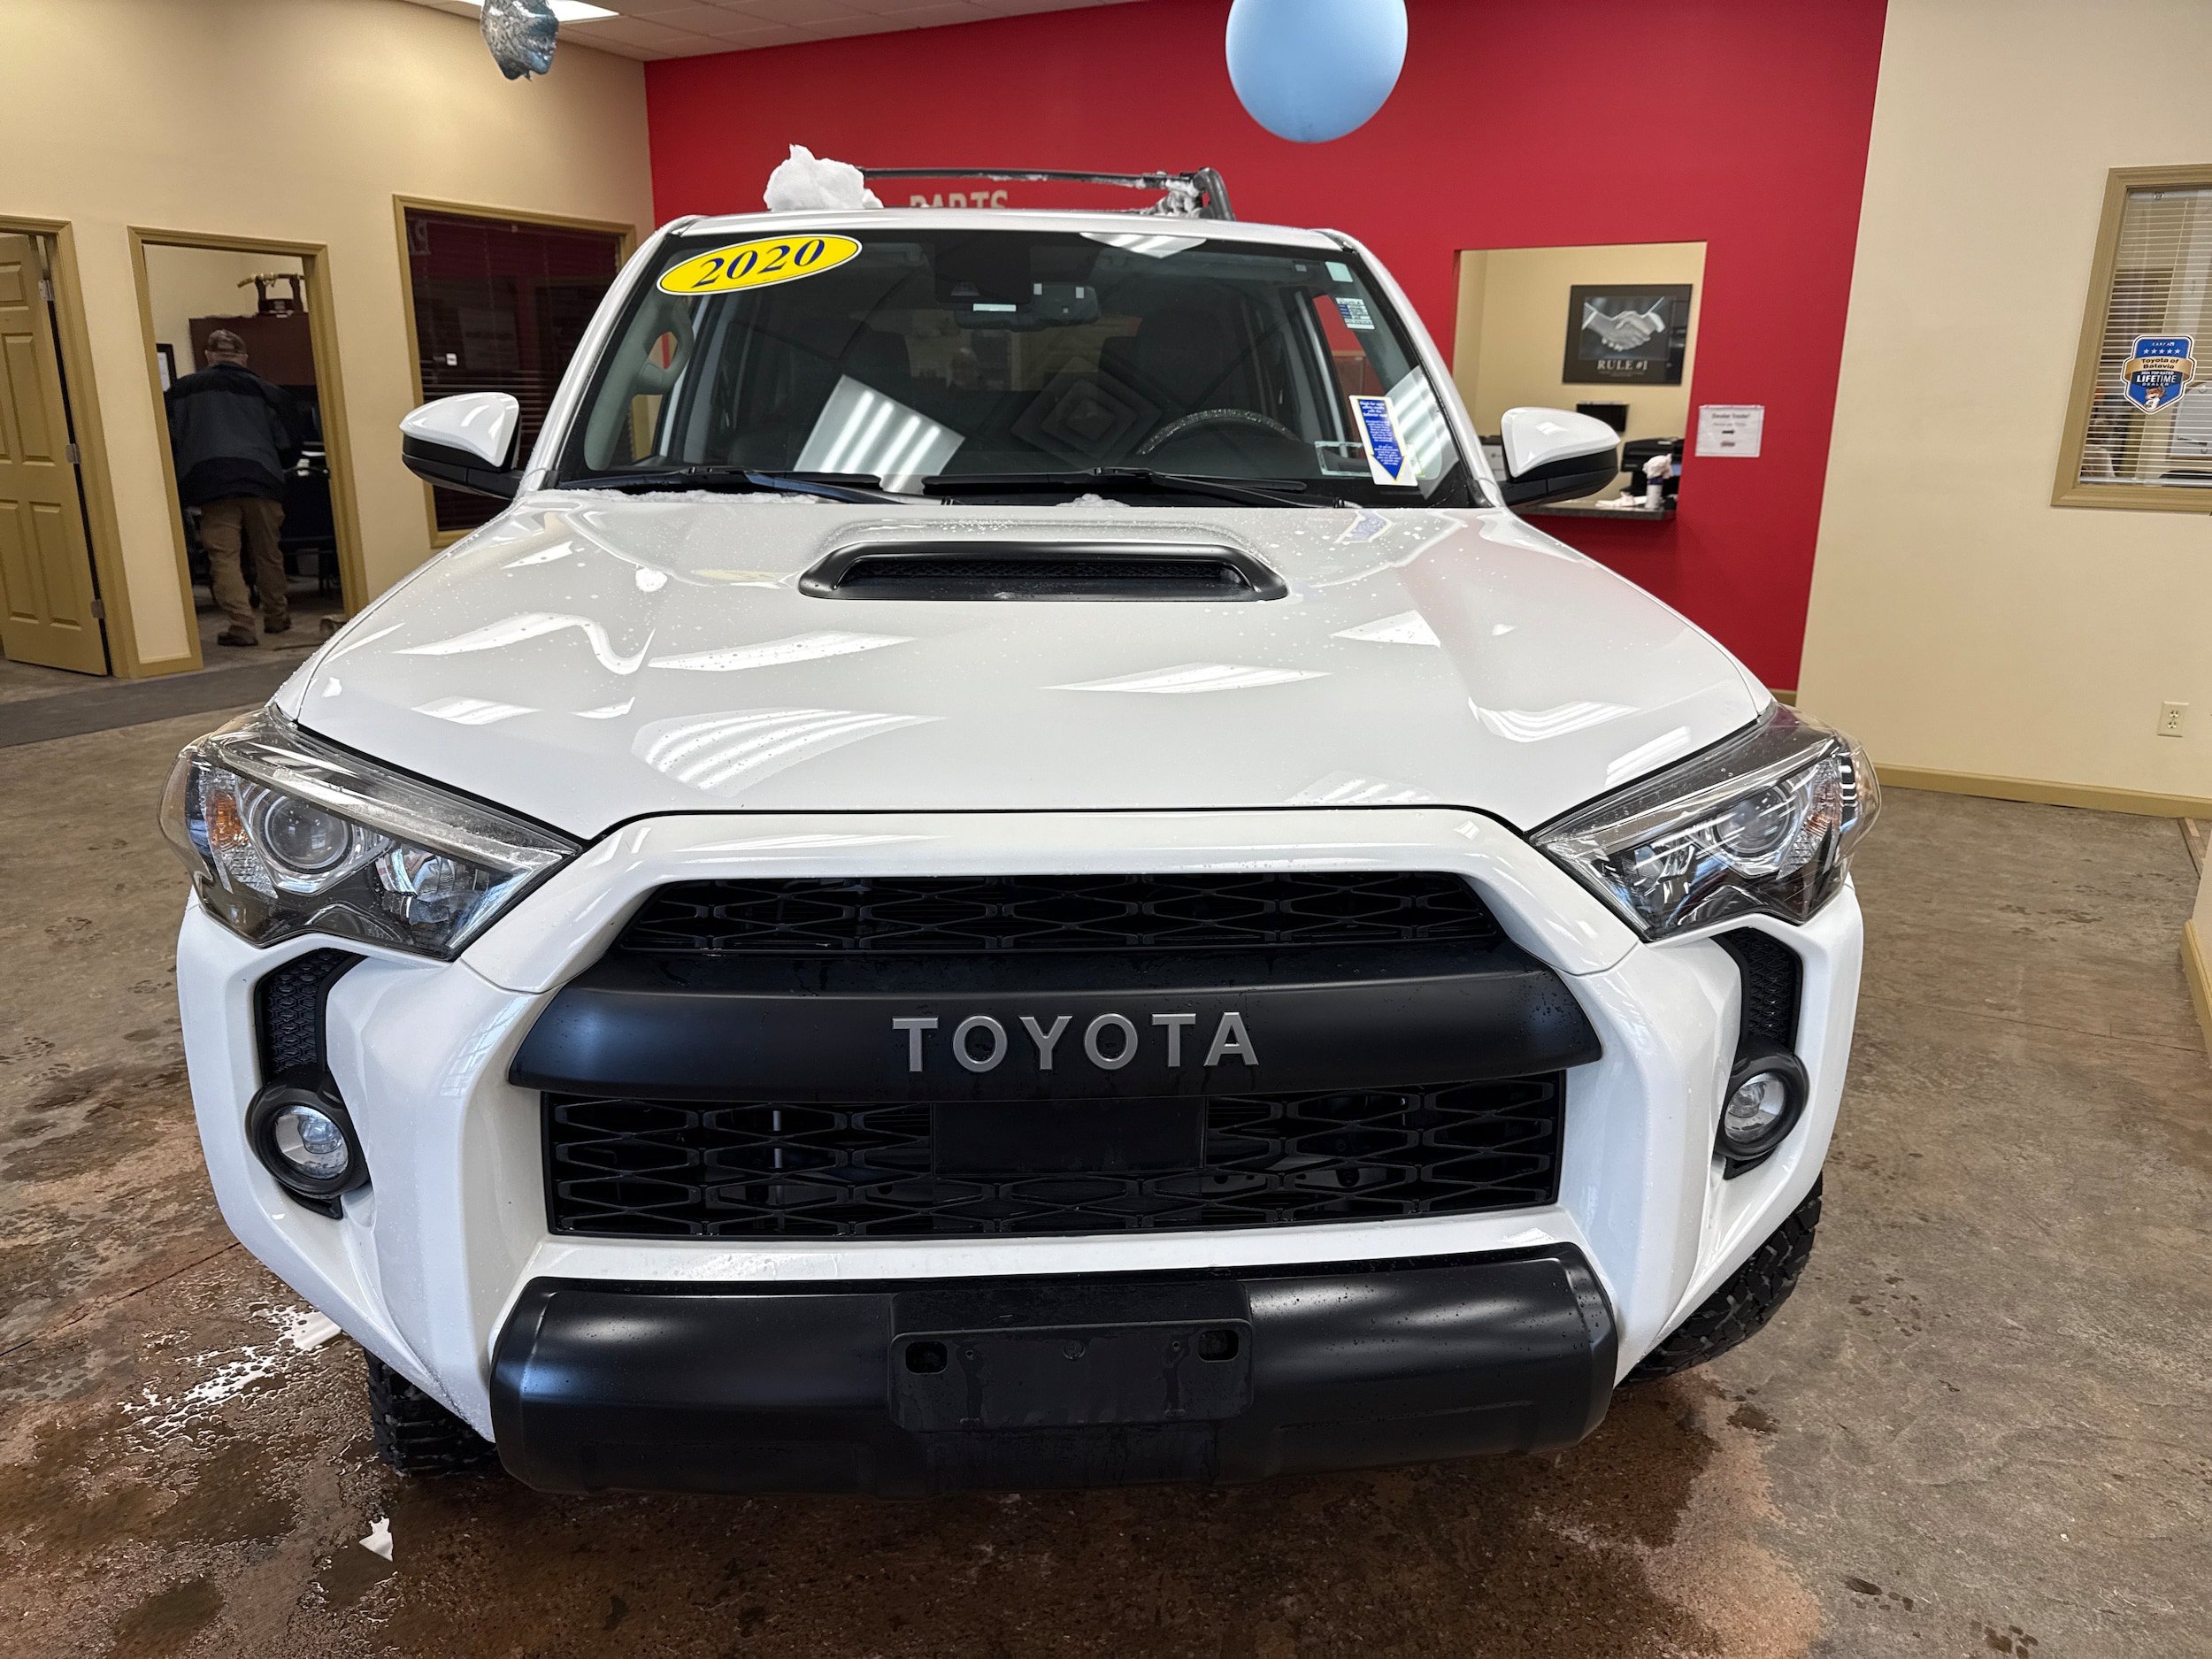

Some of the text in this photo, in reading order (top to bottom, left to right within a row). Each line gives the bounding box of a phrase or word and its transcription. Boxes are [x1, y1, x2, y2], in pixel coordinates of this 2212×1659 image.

[690, 239, 826, 289] 2020
[1596, 359, 1633, 371] RULE
[2136, 374, 2177, 383] LIFETIME
[892, 1012, 1260, 1072] TOYOTA
